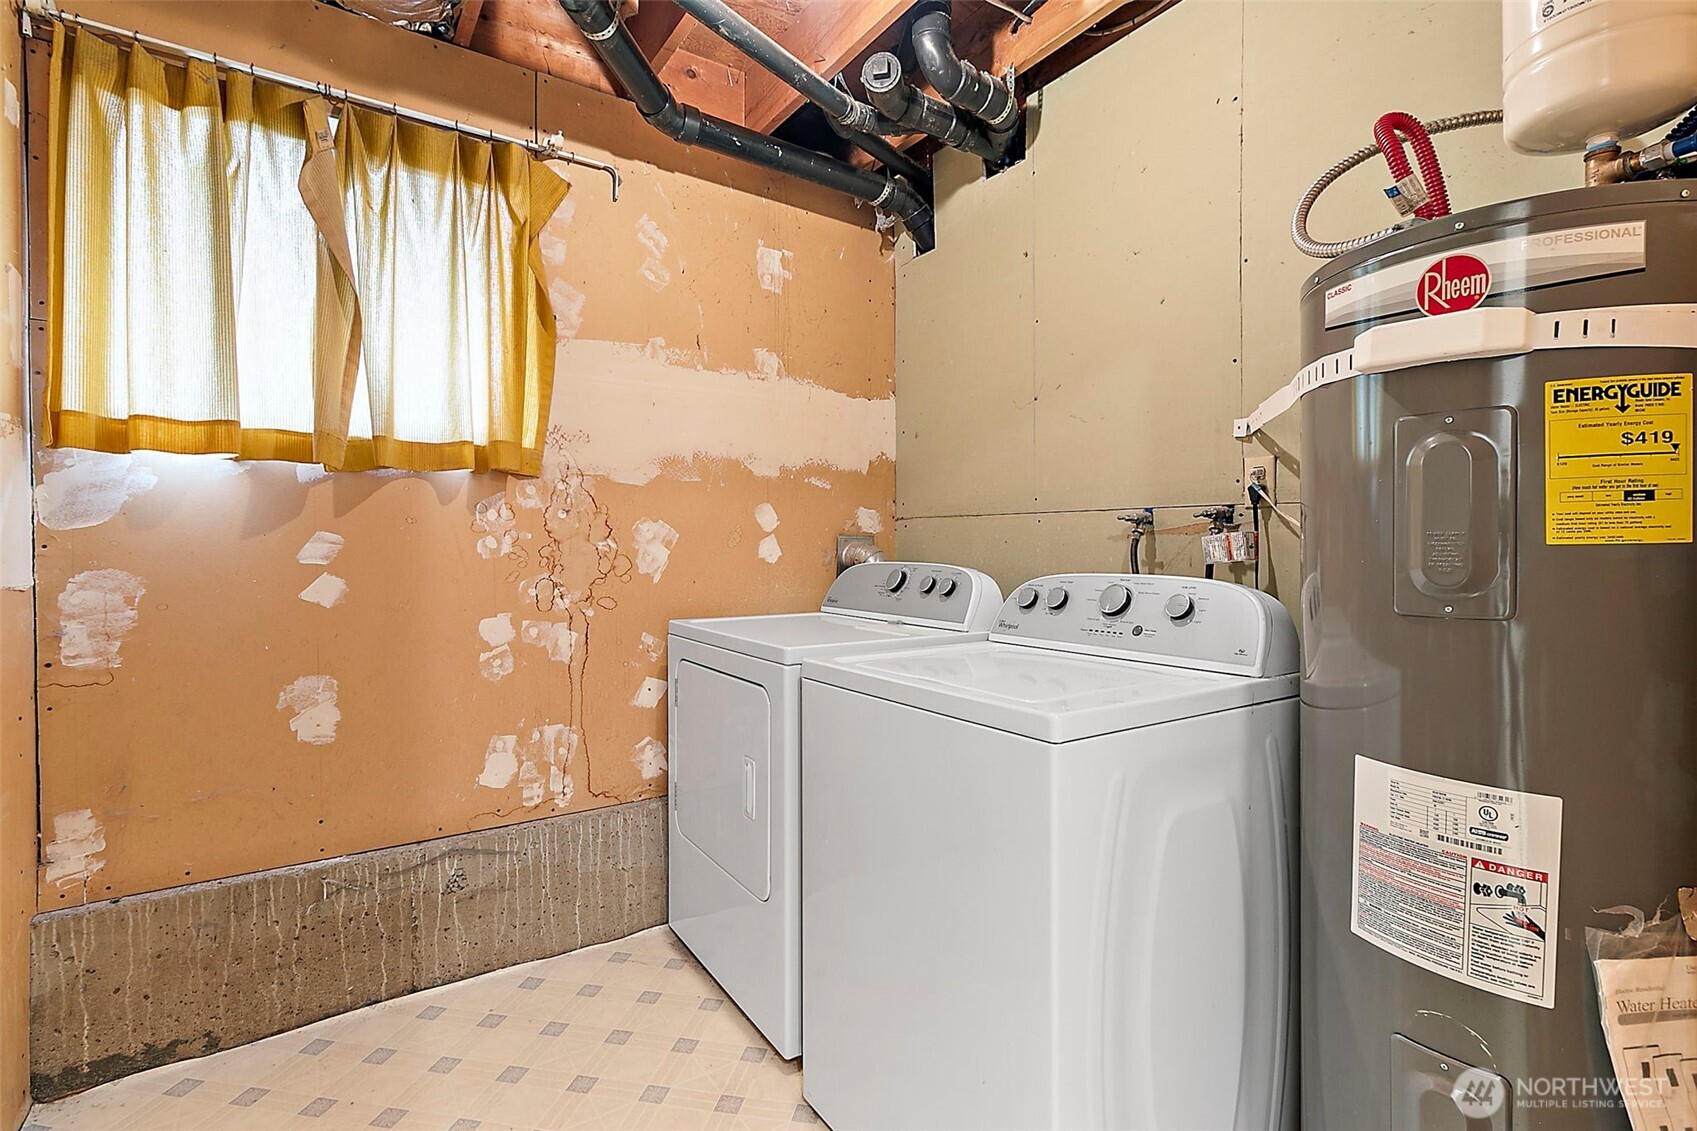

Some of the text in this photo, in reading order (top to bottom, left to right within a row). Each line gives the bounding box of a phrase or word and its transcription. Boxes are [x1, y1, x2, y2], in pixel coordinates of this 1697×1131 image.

[1327, 284, 1352, 300] CLASSIC
[1424, 258, 1487, 311] Rheem
[1553, 382, 1682, 407] ENERGYGUIDE
[1621, 430, 1673, 446] $419
[1483, 808, 1493, 819] UL
[1442, 850, 1467, 859] CAUTION
[1489, 863, 1543, 881] DANGER
[1513, 905, 1529, 913] HOT
[1616, 999, 1656, 1013] Water
